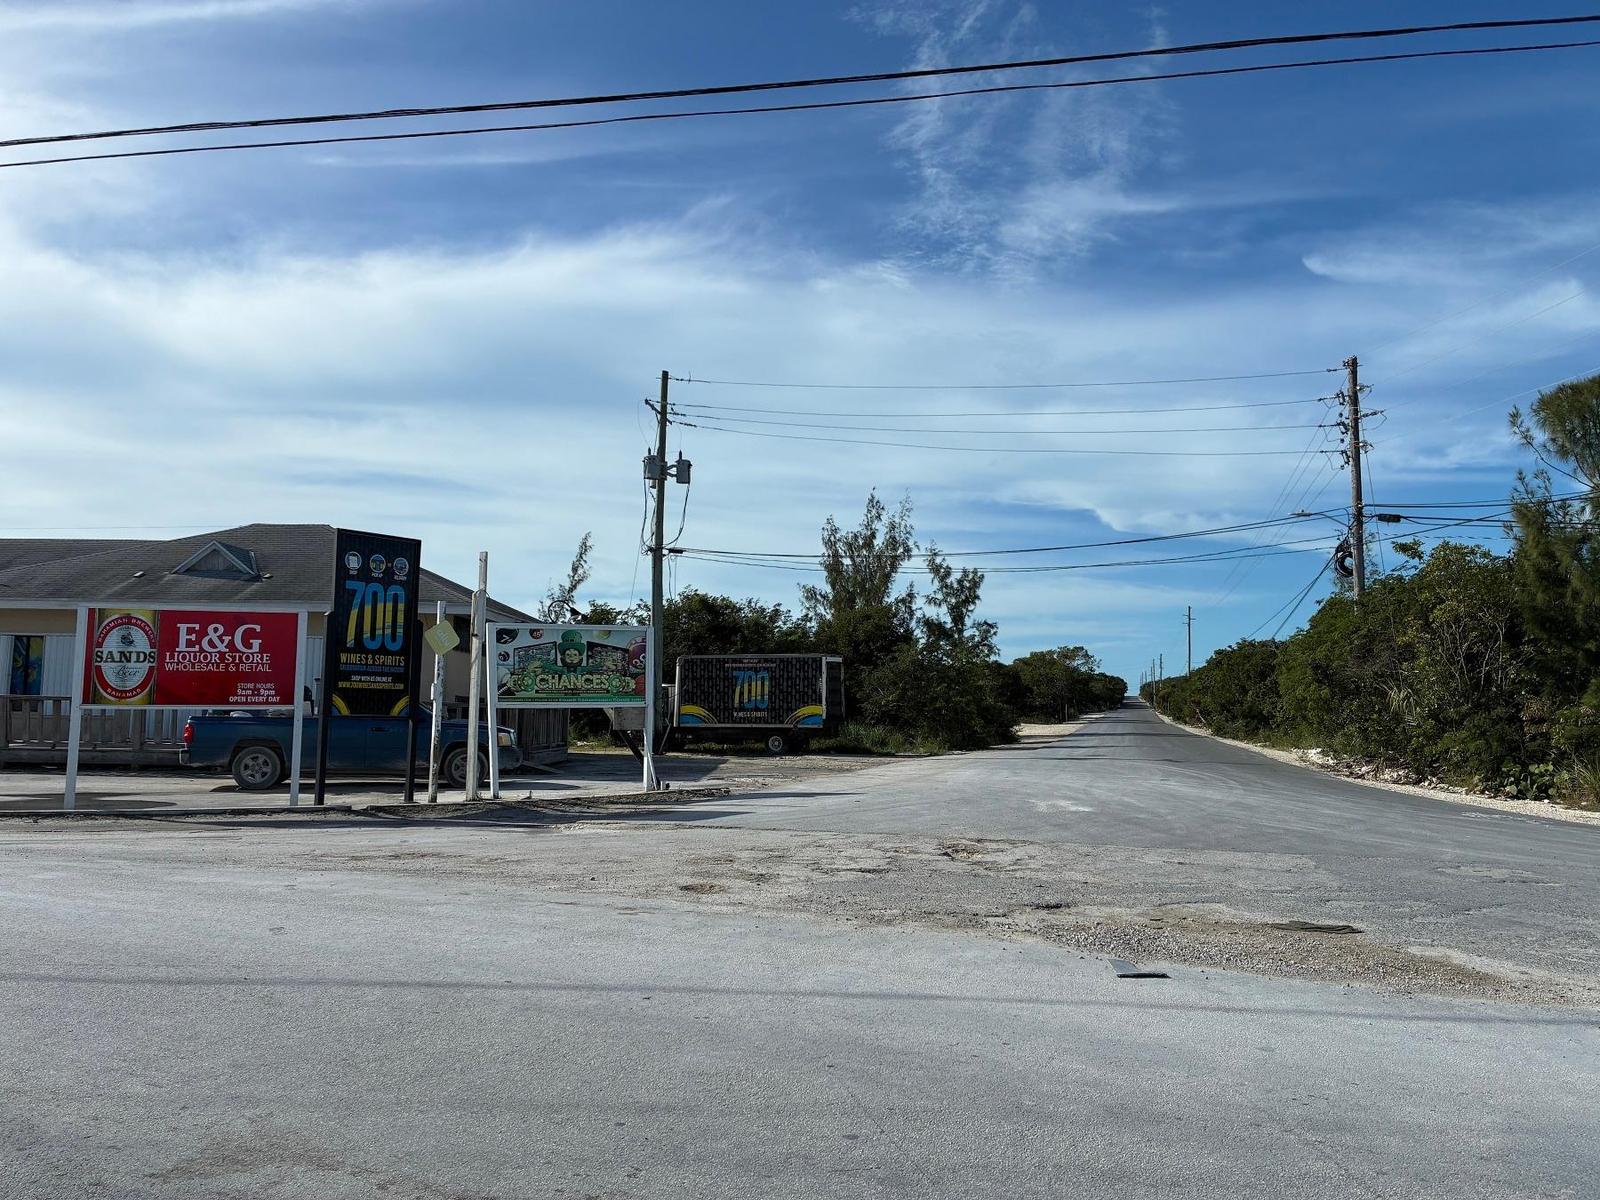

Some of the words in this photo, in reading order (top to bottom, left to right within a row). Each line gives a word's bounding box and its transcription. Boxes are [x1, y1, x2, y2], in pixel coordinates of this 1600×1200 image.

[345, 580, 405, 651] 700
[175, 623, 262, 653] E&G
[95, 650, 156, 664] SANDS
[165, 652, 220, 664] LIQUOR
[224, 653, 271, 663] STORE
[340, 652, 366, 664] WINES
[367, 654, 373, 665] &
[374, 654, 405, 666] SPIRITS
[164, 663, 226, 672] WHOLESALE
[228, 663, 236, 672] &
[239, 663, 272, 672] RETAIL
[535, 674, 609, 689] CHANCES
[259, 689, 275, 697] 9pm
[733, 670, 769, 709] 700
